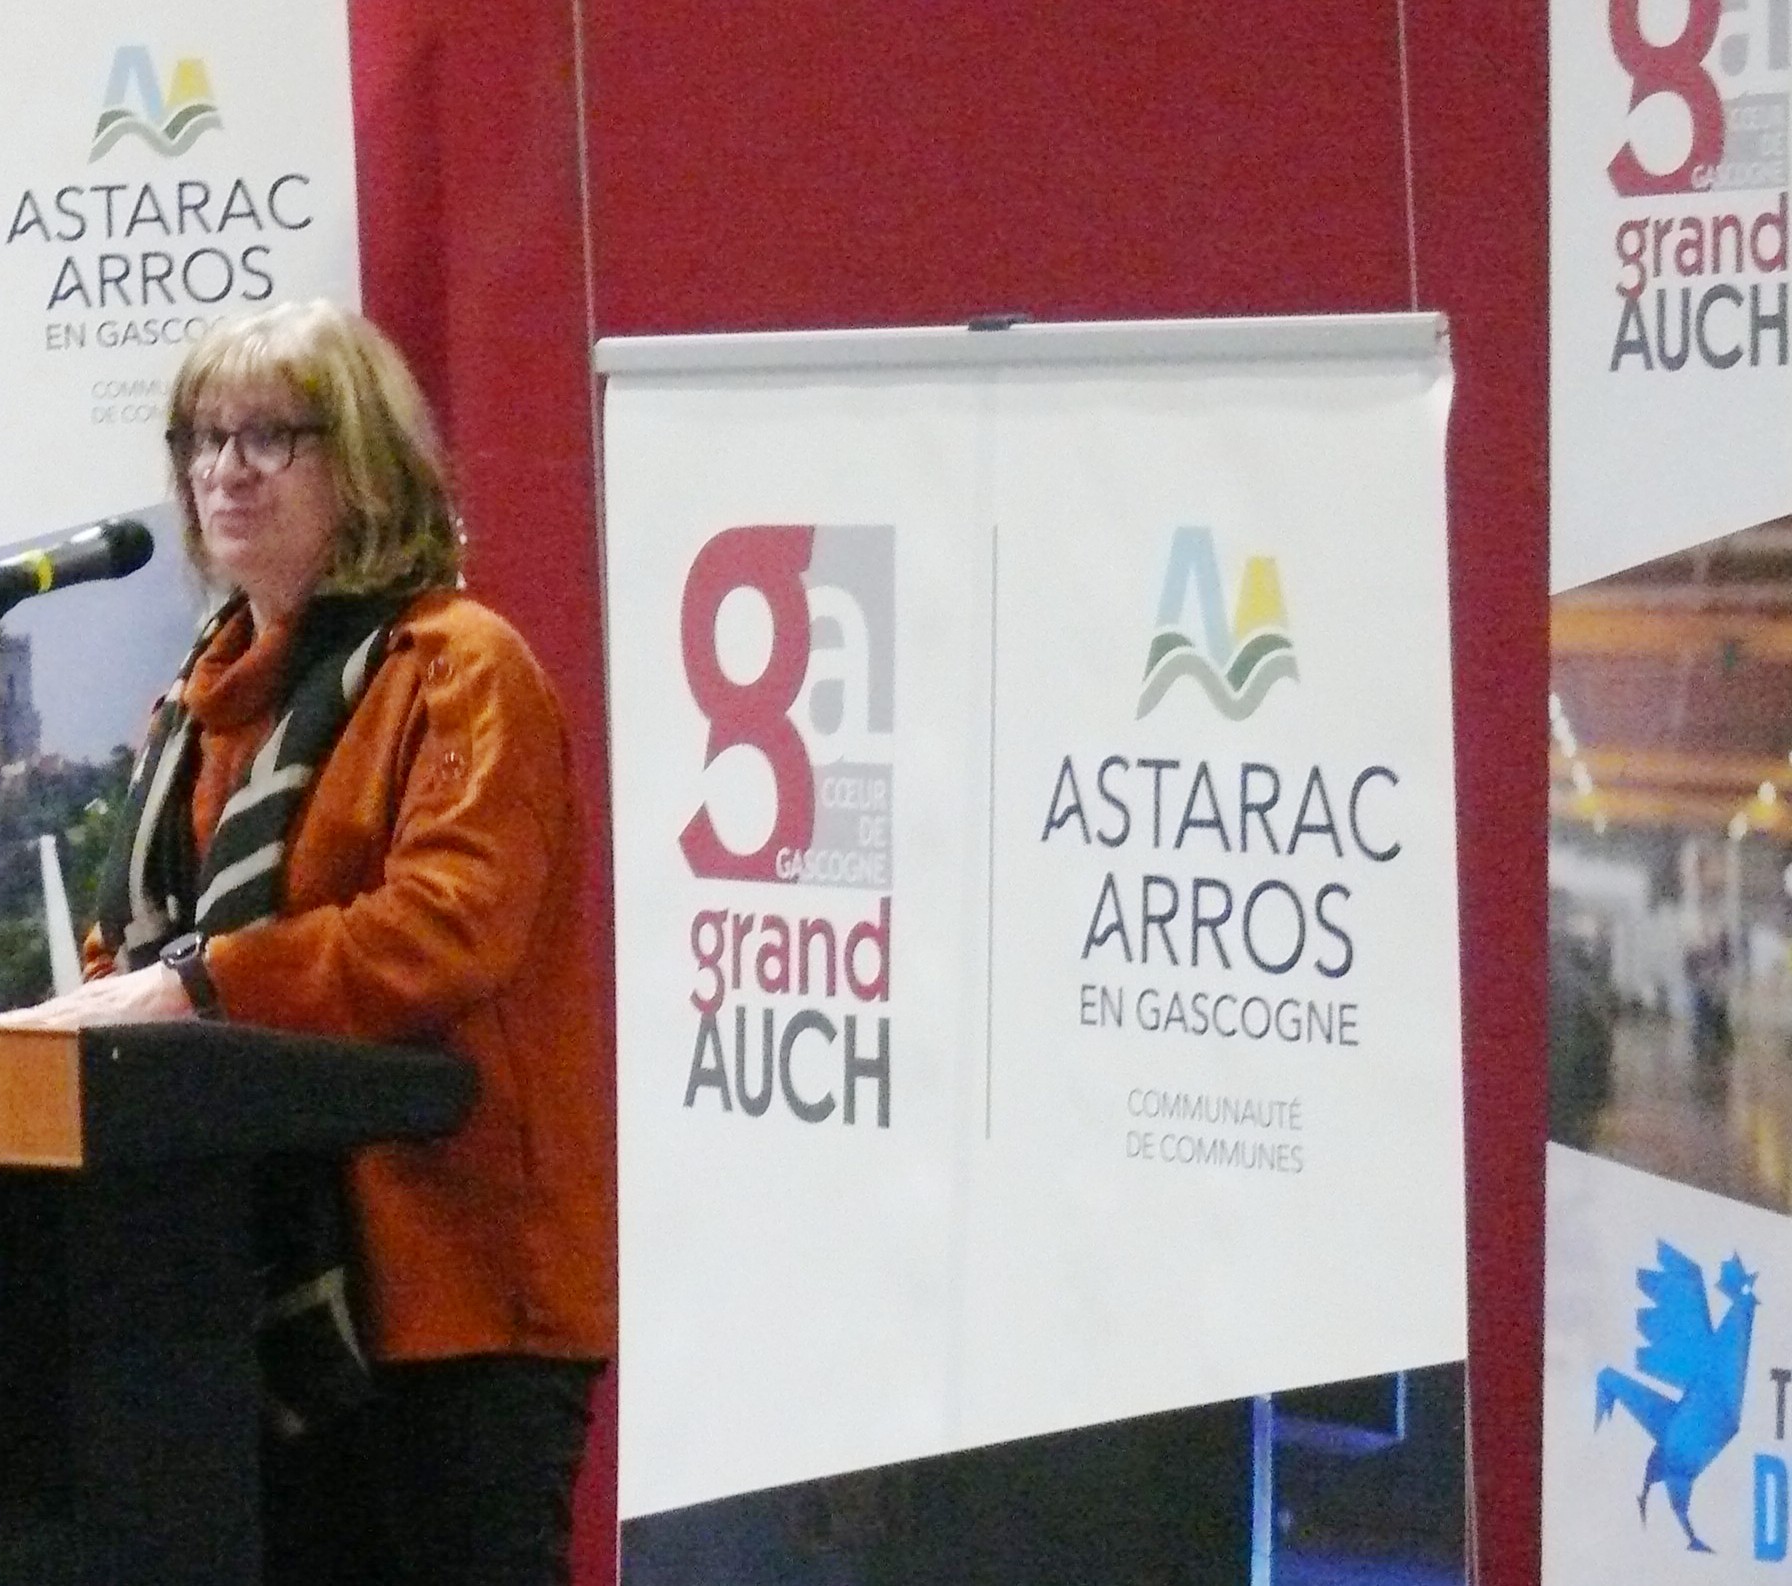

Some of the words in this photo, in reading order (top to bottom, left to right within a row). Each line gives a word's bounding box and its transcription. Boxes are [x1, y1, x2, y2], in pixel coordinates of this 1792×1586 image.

[6, 174, 315, 246] ASTARAC
[46, 244, 275, 311] ARROS
[1614, 191, 1790, 300] grand
[46, 321, 86, 350] EN
[94, 315, 226, 349] GASCO
[1608, 281, 1790, 373] AUCH
[858, 814, 888, 849] DE
[1039, 753, 1403, 863] ASTARAC
[775, 847, 889, 885] GASCOGNE
[689, 896, 892, 1016] grand
[1080, 869, 1355, 980] ARROS
[1078, 984, 1124, 1029] EN
[1135, 989, 1361, 1047] GASCOGNE
[682, 1003, 892, 1129] AUCH
[1127, 1087, 1304, 1131] COMMUNAUTÉ
[1125, 1129, 1155, 1160] DE
[1159, 1132, 1305, 1174] COMMUNES
